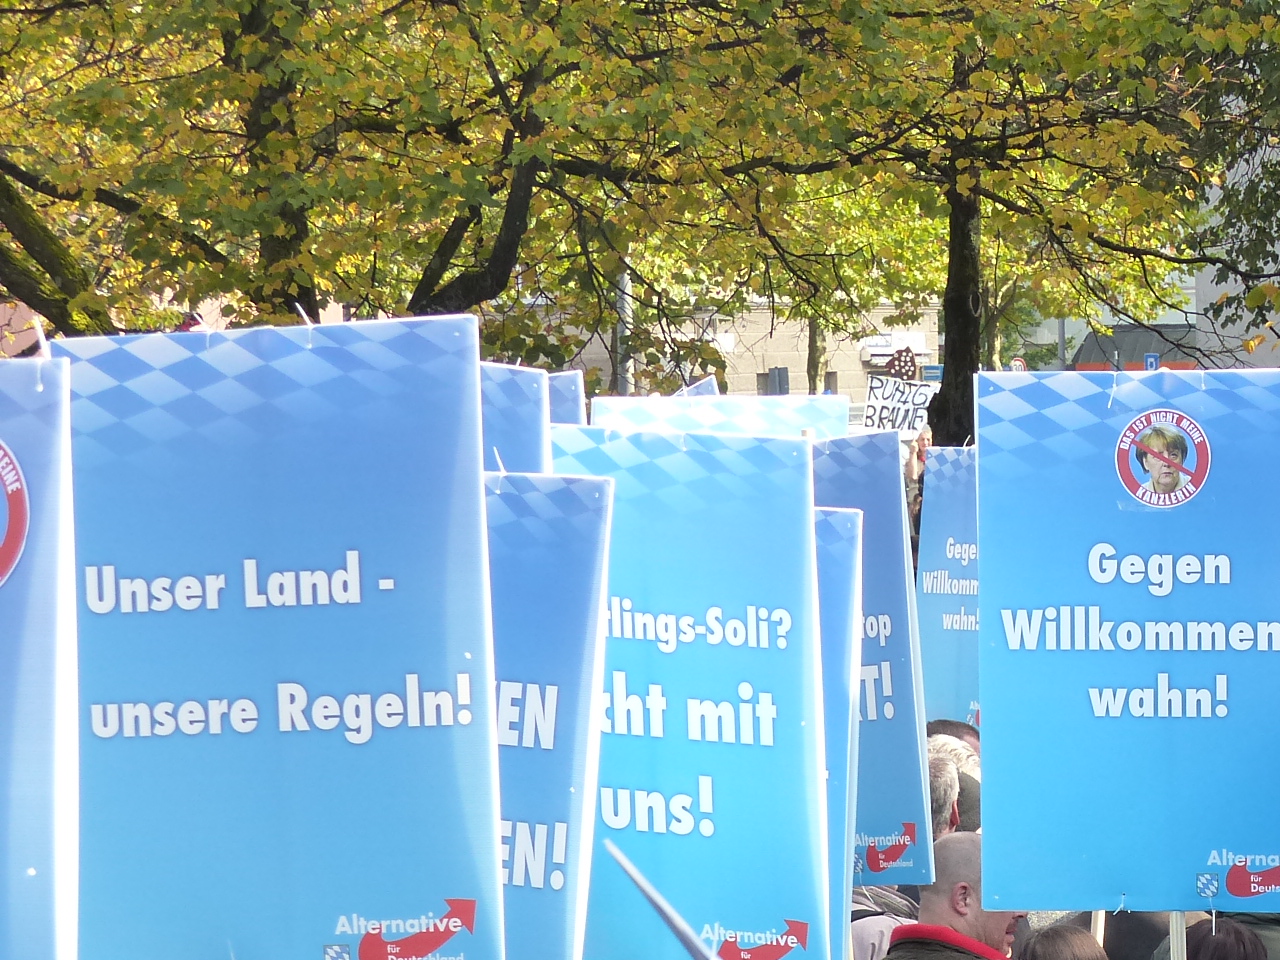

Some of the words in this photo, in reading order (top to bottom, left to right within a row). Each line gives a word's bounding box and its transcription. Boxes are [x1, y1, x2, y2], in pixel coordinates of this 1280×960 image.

[868, 376, 930, 407] RUHIG
[1120, 430, 1135, 451] DAS
[1132, 416, 1148, 432] IST
[1150, 411, 1179, 423] NICHT
[1179, 418, 1204, 445] MEINE
[1136, 482, 1196, 505] KANZLERIN
[946, 537, 978, 566] Gege
[85, 566, 225, 613] Unser
[243, 550, 361, 608] Land
[1088, 542, 1231, 596] Gegen
[90, 697, 258, 737] unsere
[277, 673, 471, 744] Regeln!
[1089, 673, 1228, 718] wahn!
[687, 681, 777, 746] mit
[601, 775, 714, 837] uns!
[855, 831, 911, 846] Alternative
[1250, 874, 1263, 883] für
[335, 913, 462, 935] Alternative
[700, 921, 798, 948] Alternative
[387, 944, 401, 954] für
[740, 951, 751, 960] für
